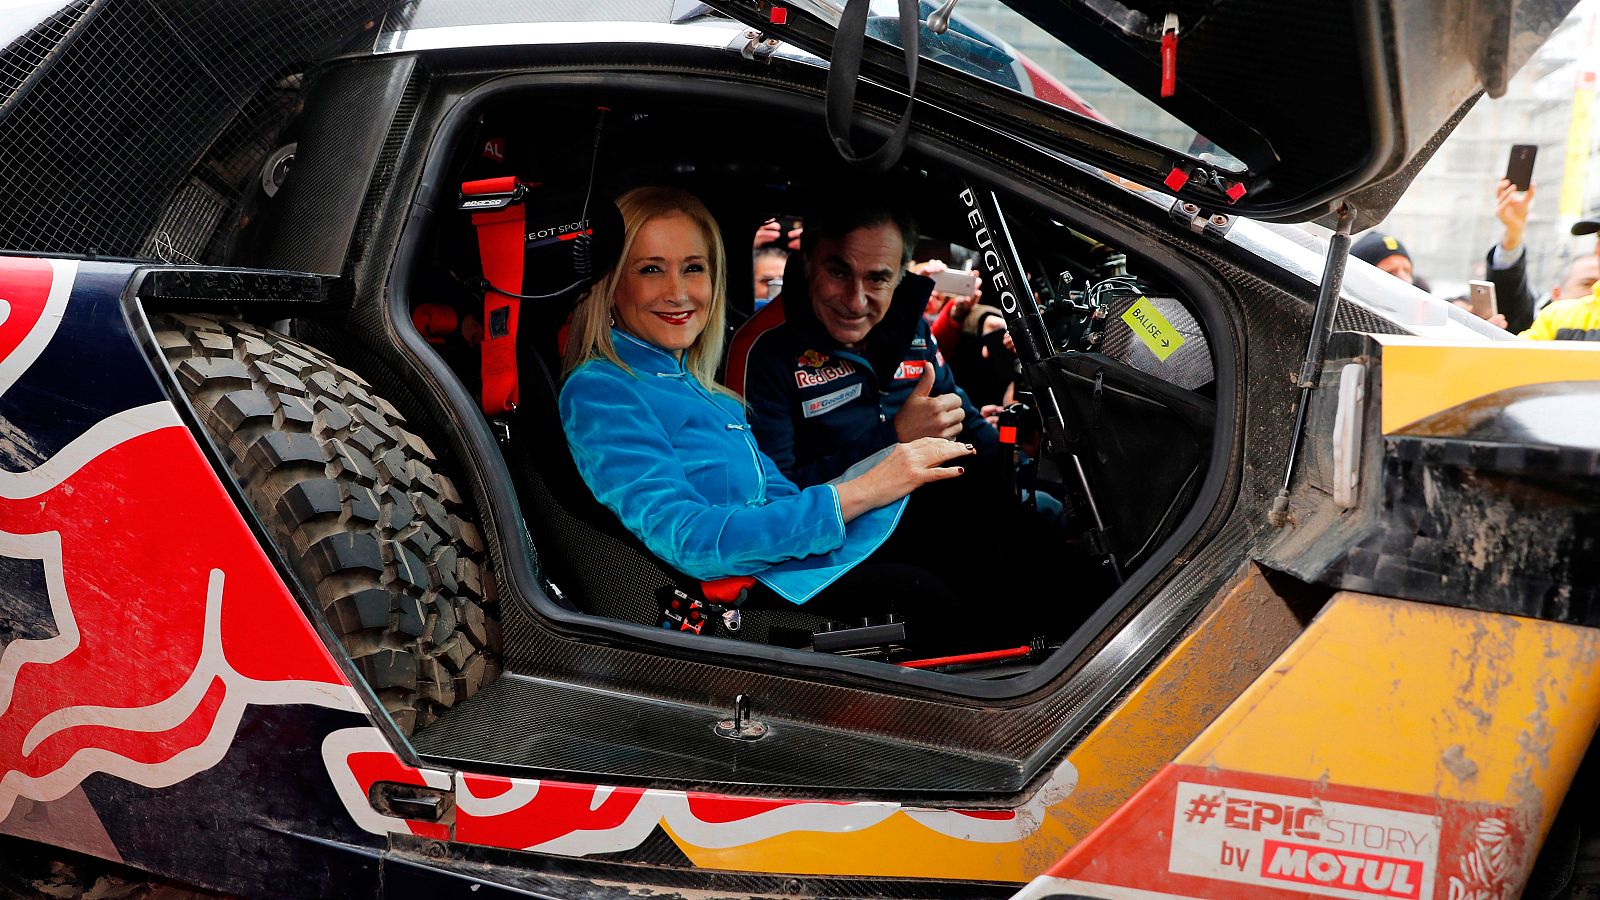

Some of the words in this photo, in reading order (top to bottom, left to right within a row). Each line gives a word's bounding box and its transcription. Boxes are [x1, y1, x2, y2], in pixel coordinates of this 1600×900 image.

[959, 187, 1022, 319] PEUGEO
[1132, 308, 1162, 340] BALISE
[794, 368, 827, 388] Red
[822, 359, 857, 382] Bull
[1220, 840, 1250, 872] by
[1266, 846, 1416, 895] MOTUL
